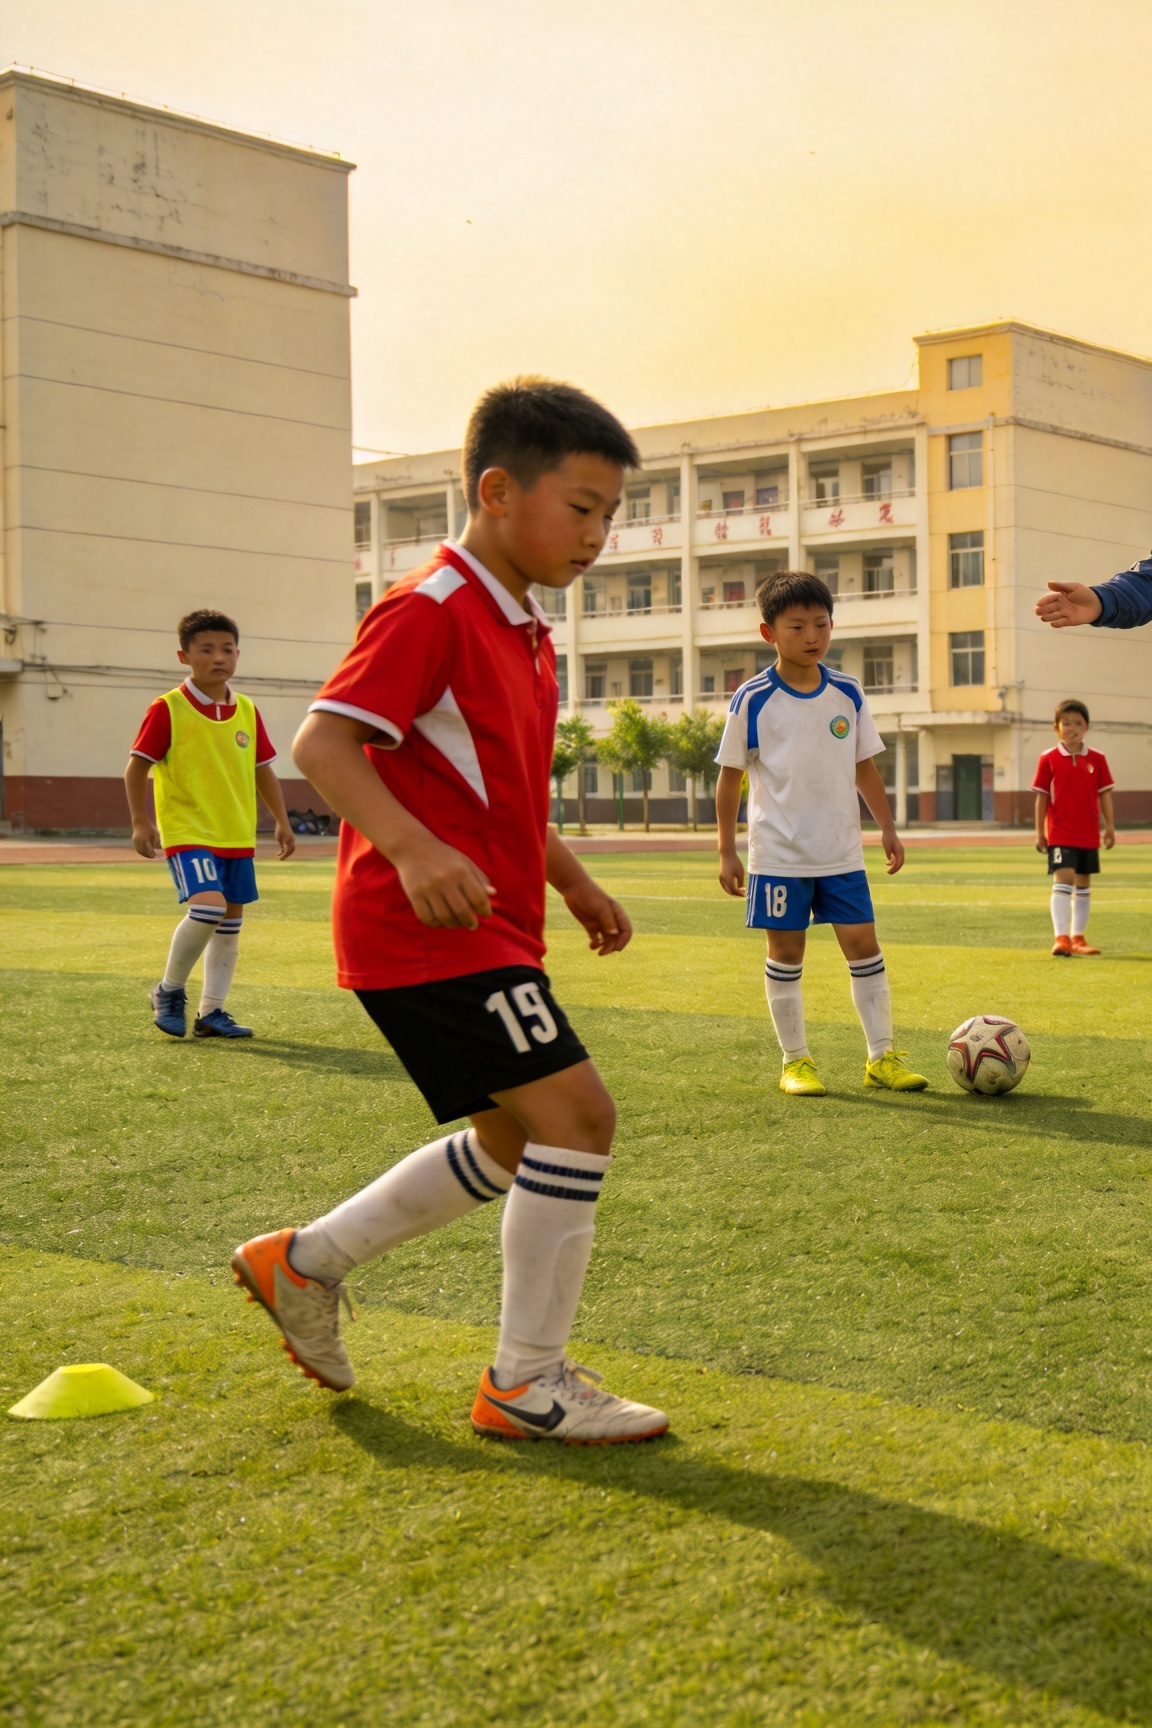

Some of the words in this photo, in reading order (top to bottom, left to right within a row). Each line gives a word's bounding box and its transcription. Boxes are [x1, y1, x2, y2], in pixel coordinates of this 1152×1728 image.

[191, 858, 217, 883] 10
[765, 882, 787, 918] 18
[484, 981, 558, 1053] 19
